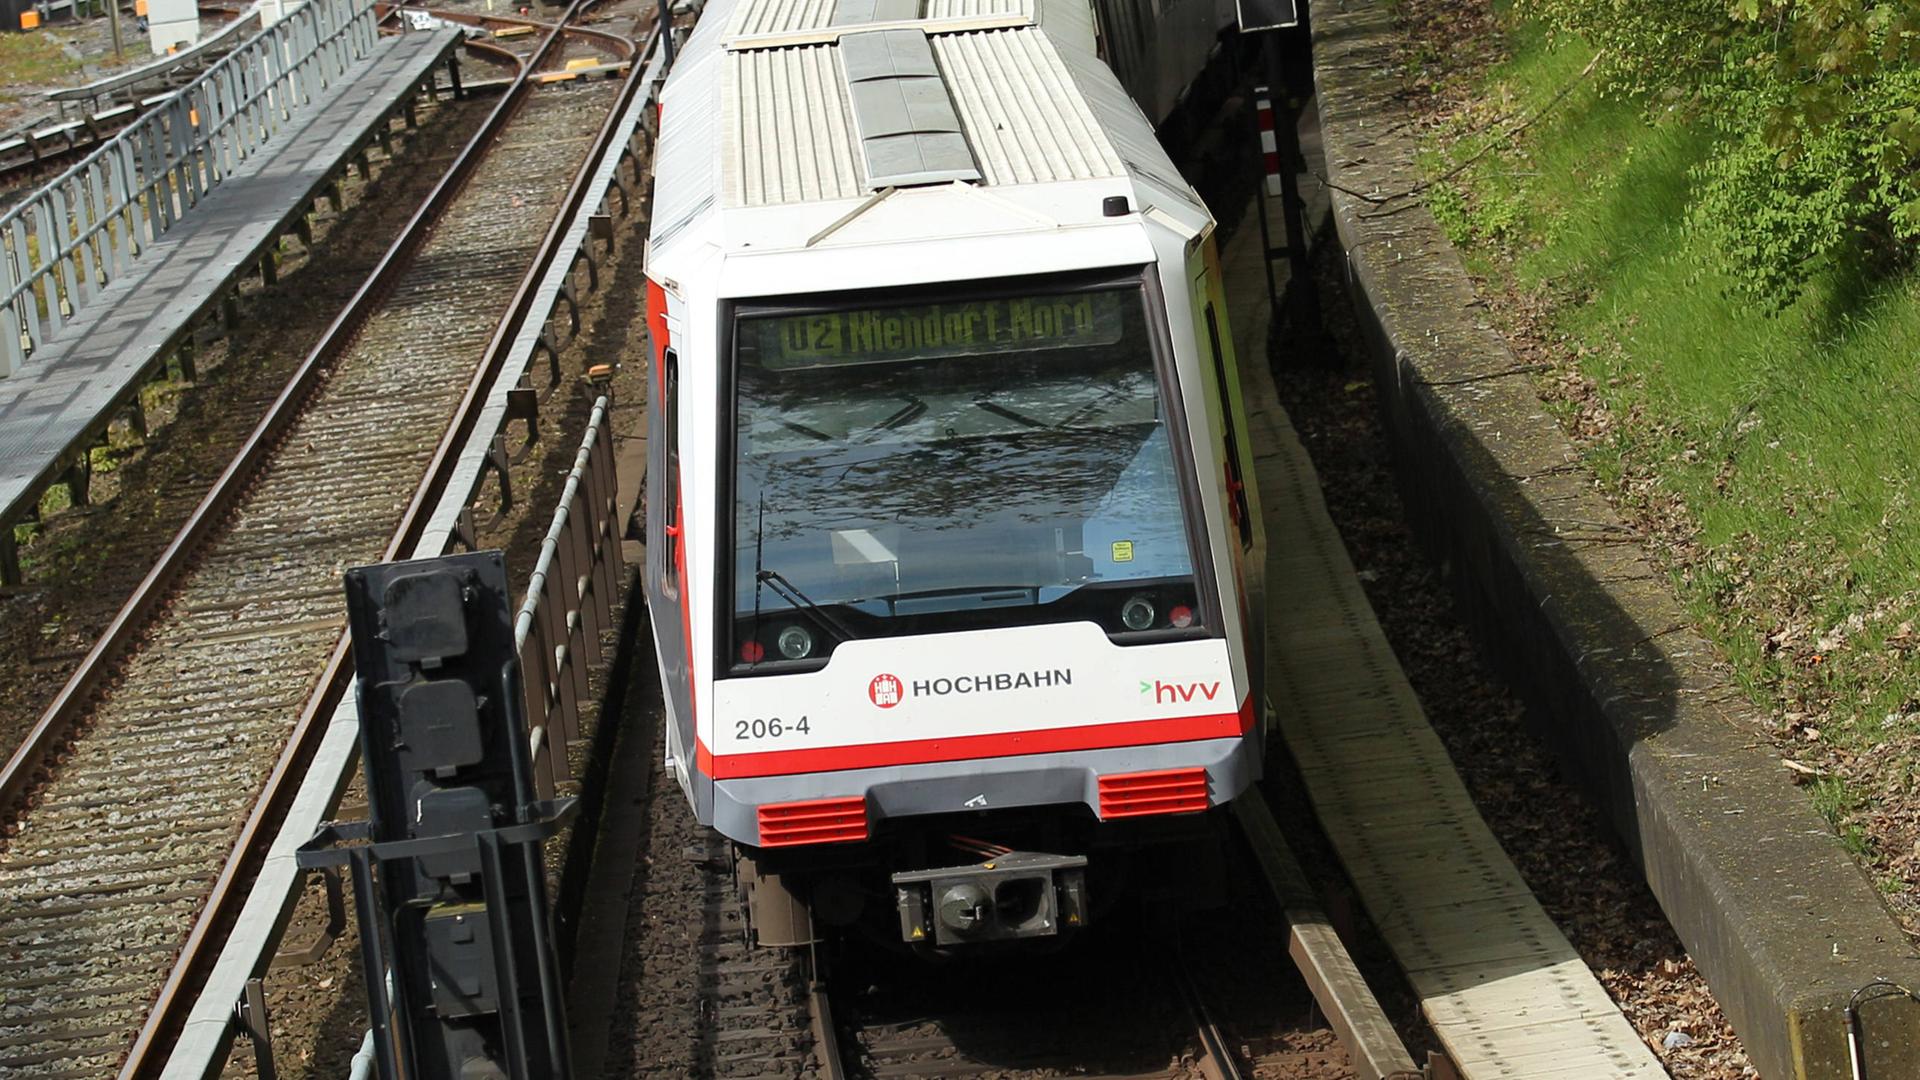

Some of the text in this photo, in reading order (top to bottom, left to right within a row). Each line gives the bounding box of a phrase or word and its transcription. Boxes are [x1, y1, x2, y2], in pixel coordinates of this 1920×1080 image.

[786, 316, 836, 352] U2
[1010, 297, 1094, 341] Nord
[912, 668, 1073, 697] HOCHBAHN
[735, 715, 811, 740] 206-4
